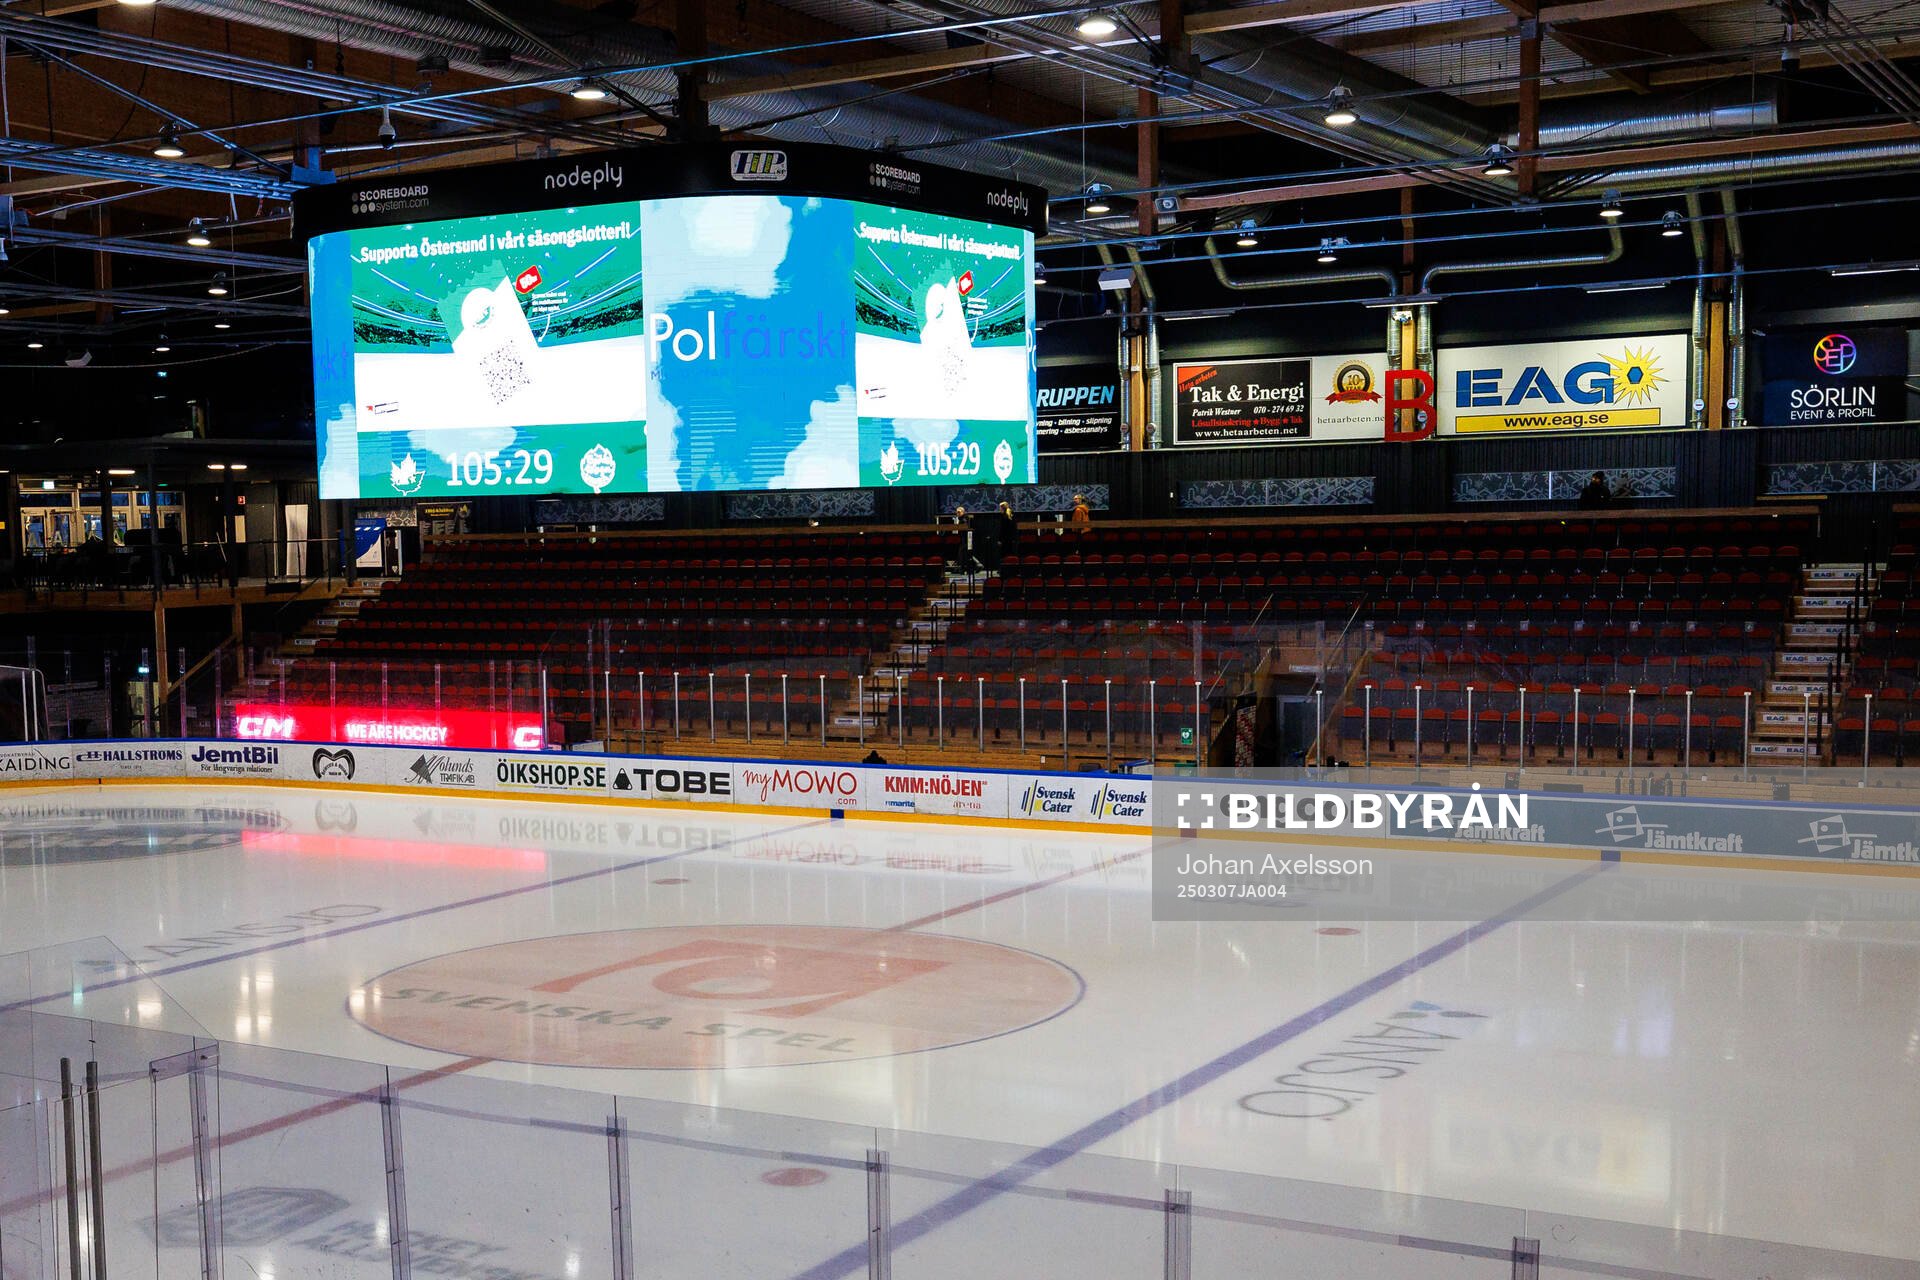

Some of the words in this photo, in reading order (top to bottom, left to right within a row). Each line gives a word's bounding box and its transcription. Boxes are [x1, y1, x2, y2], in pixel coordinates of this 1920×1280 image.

[544, 161, 623, 190] nodeply
[875, 163, 921, 184] SCOREBOARD
[359, 185, 429, 202] SCOREBOARD
[987, 188, 1029, 217] nodeply
[376, 197, 430, 213] system.com
[360, 243, 418, 264] Supporta
[420, 235, 487, 257] Östersund
[497, 229, 525, 250] vårt
[527, 221, 631, 248] säsongslotteri!
[860, 221, 900, 244] Supporta
[901, 224, 943, 249] Östersund
[948, 233, 965, 252] vårt
[649, 309, 848, 362] Polfärskt
[1347, 374, 1361, 386] 10
[1455, 361, 1614, 408] EAG
[1190, 385, 1222, 403] Tak
[1227, 384, 1242, 401] &
[1247, 382, 1304, 402] Energi
[1790, 384, 1876, 408] SÖRLIN
[1192, 408, 1213, 417] Patrik
[1253, 406, 1266, 414] 070
[1272, 405, 1284, 413] 274
[1285, 405, 1294, 413] 69
[1295, 404, 1304, 413] 32
[1384, 369, 1437, 442] B
[1790, 410, 1824, 420] EVENT
[1826, 409, 1835, 419] &
[1838, 408, 1876, 418] PROFIL
[1260, 417, 1280, 427] Bygg
[1317, 416, 1385, 424] hetaarbeten.ne
[1504, 412, 1609, 428] www.eag.se
[1195, 427, 1298, 438] www.hetaarbeten.net
[446, 449, 554, 486] 105:29
[916, 442, 981, 476] 105:29
[345, 723, 368, 739] WE
[369, 724, 392, 740] ARE
[394, 724, 447, 742] HOCKEY
[191, 746, 279, 765] JemtBil
[200, 764, 212, 772] För
[213, 764, 245, 774] långvariga
[497, 759, 606, 788] ÖIKSHOP.SE
[634, 769, 731, 795] TOBE
[885, 775, 982, 797] KMM:NÖJEN
[836, 797, 858, 805] .com
[1036, 786, 1075, 802] Svensk
[1107, 789, 1147, 804] Svensk
[1042, 800, 1073, 814] Cater
[1113, 803, 1145, 818] Cater
[1644, 829, 1743, 852] Jämtkraft
[387, 987, 672, 1030] SVENSKA
[684, 1023, 856, 1053] SPEL
